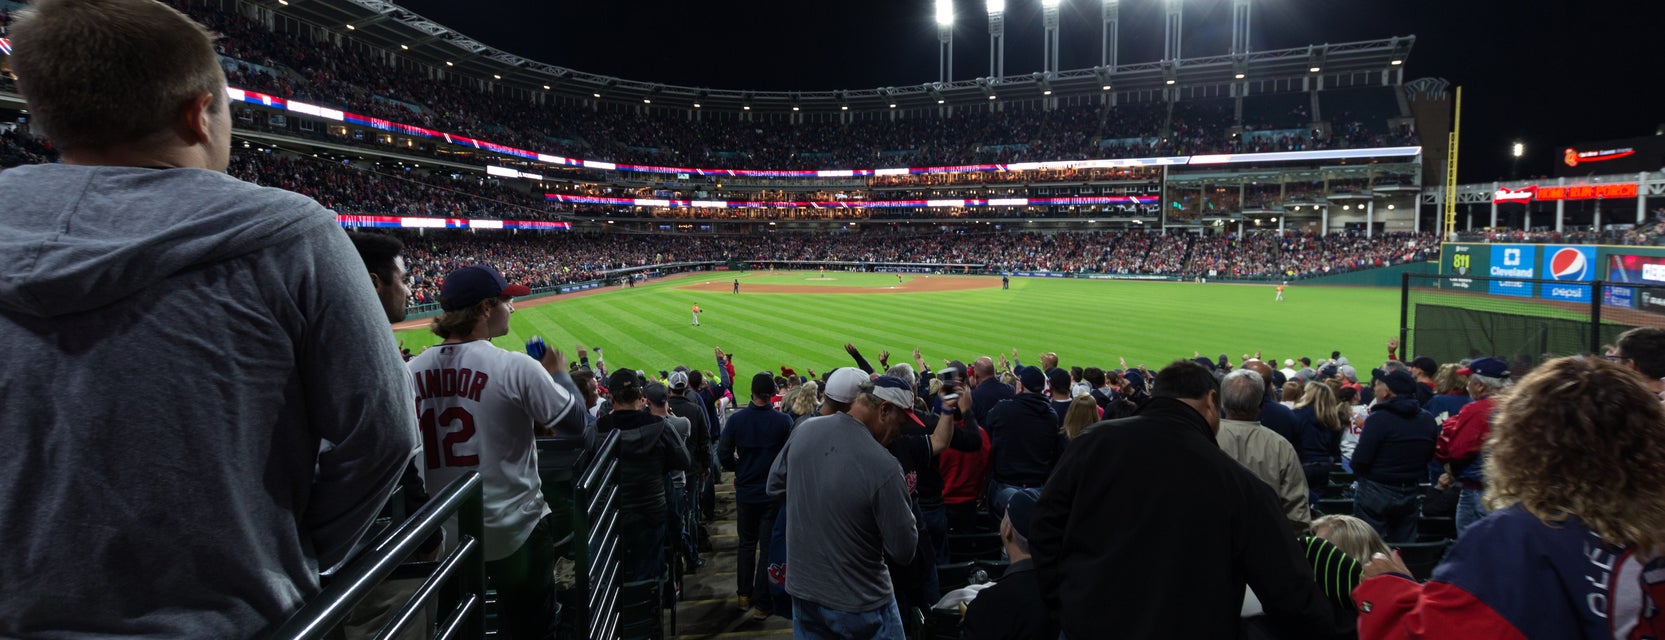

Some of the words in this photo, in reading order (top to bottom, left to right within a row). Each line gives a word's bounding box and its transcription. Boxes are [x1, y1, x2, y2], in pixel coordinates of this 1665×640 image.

[1453, 253, 1470, 269] 811
[1490, 266, 1533, 278] Cleveland
[1552, 287, 1582, 298] pepsi
[415, 368, 488, 402] INDOR
[422, 406, 479, 469] 12
